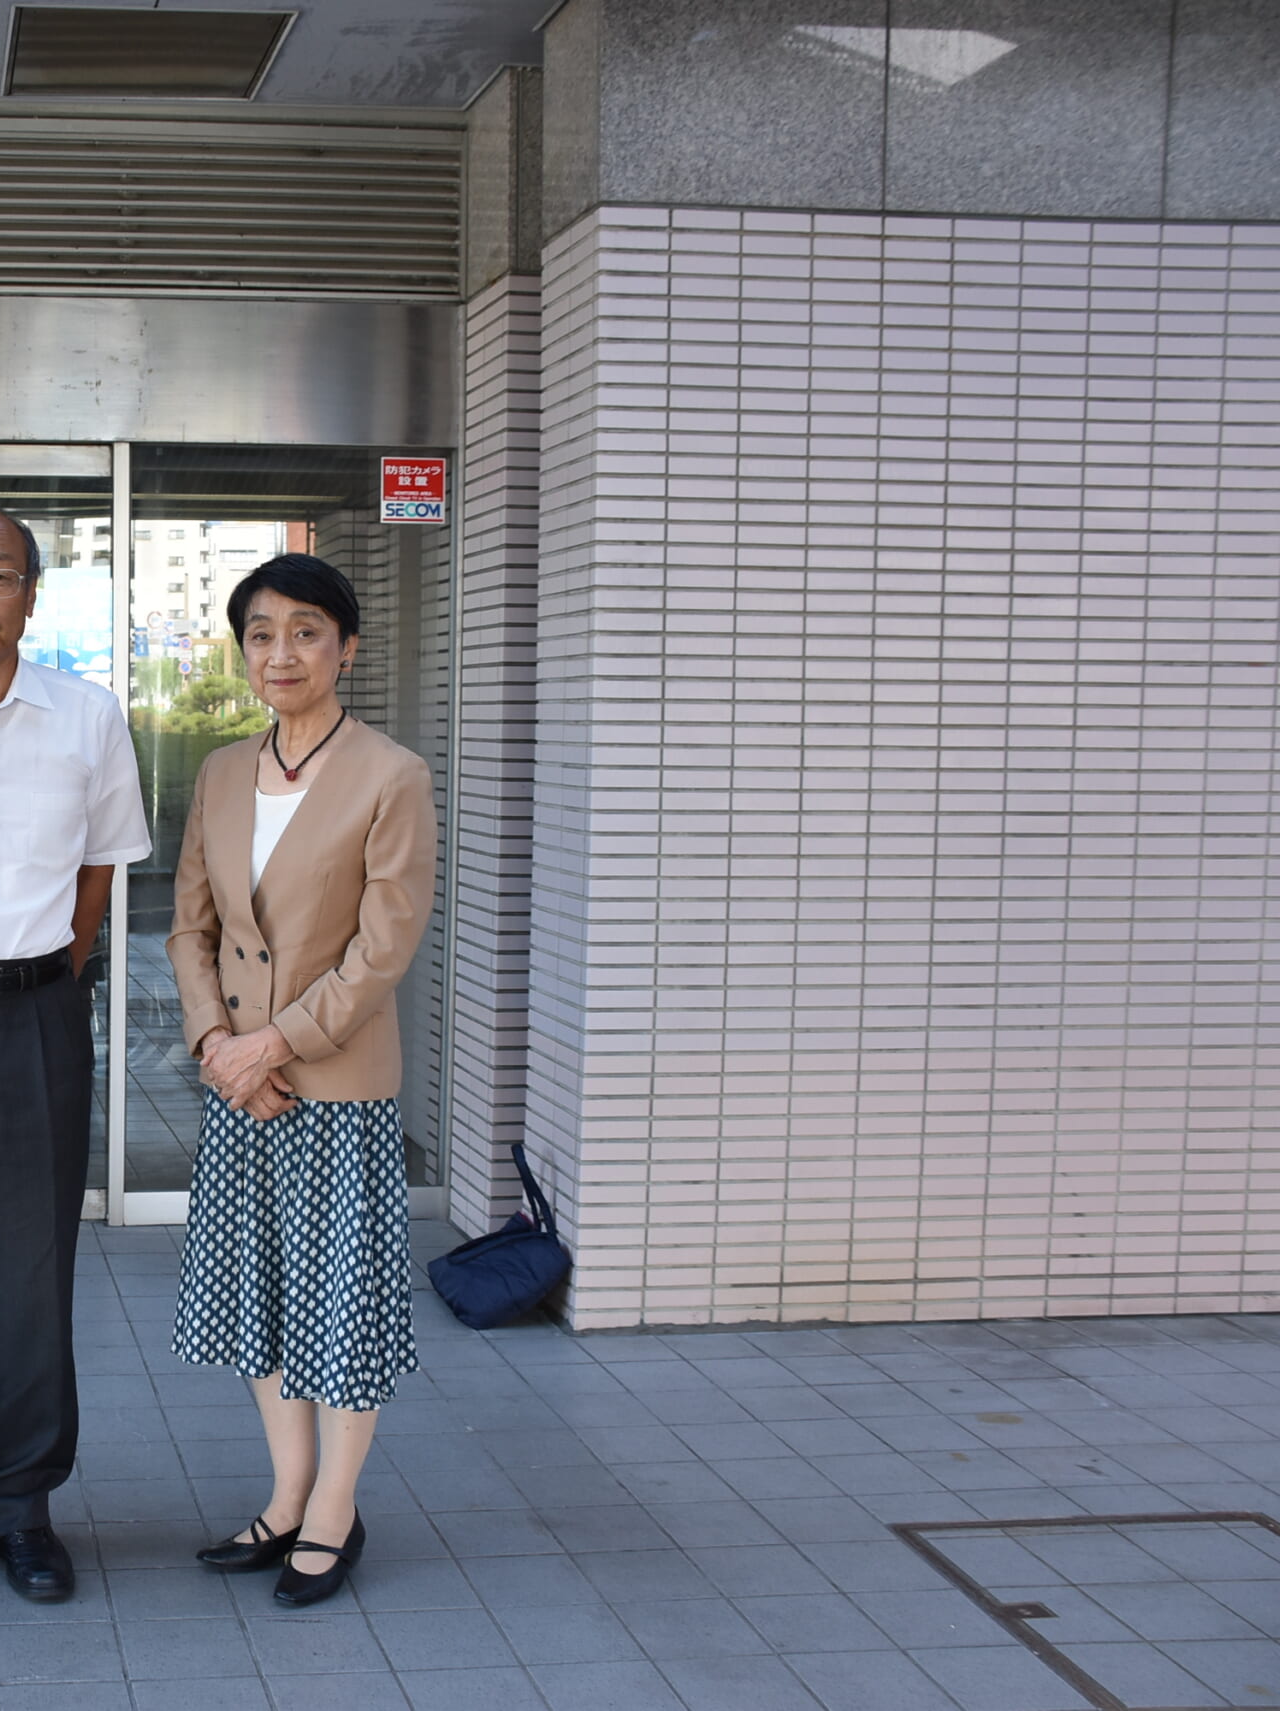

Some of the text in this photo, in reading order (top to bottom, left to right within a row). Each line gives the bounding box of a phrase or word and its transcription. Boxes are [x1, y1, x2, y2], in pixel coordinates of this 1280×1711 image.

[384, 465, 442, 476] 防犯カメラ
[385, 502, 441, 518] SECOM
